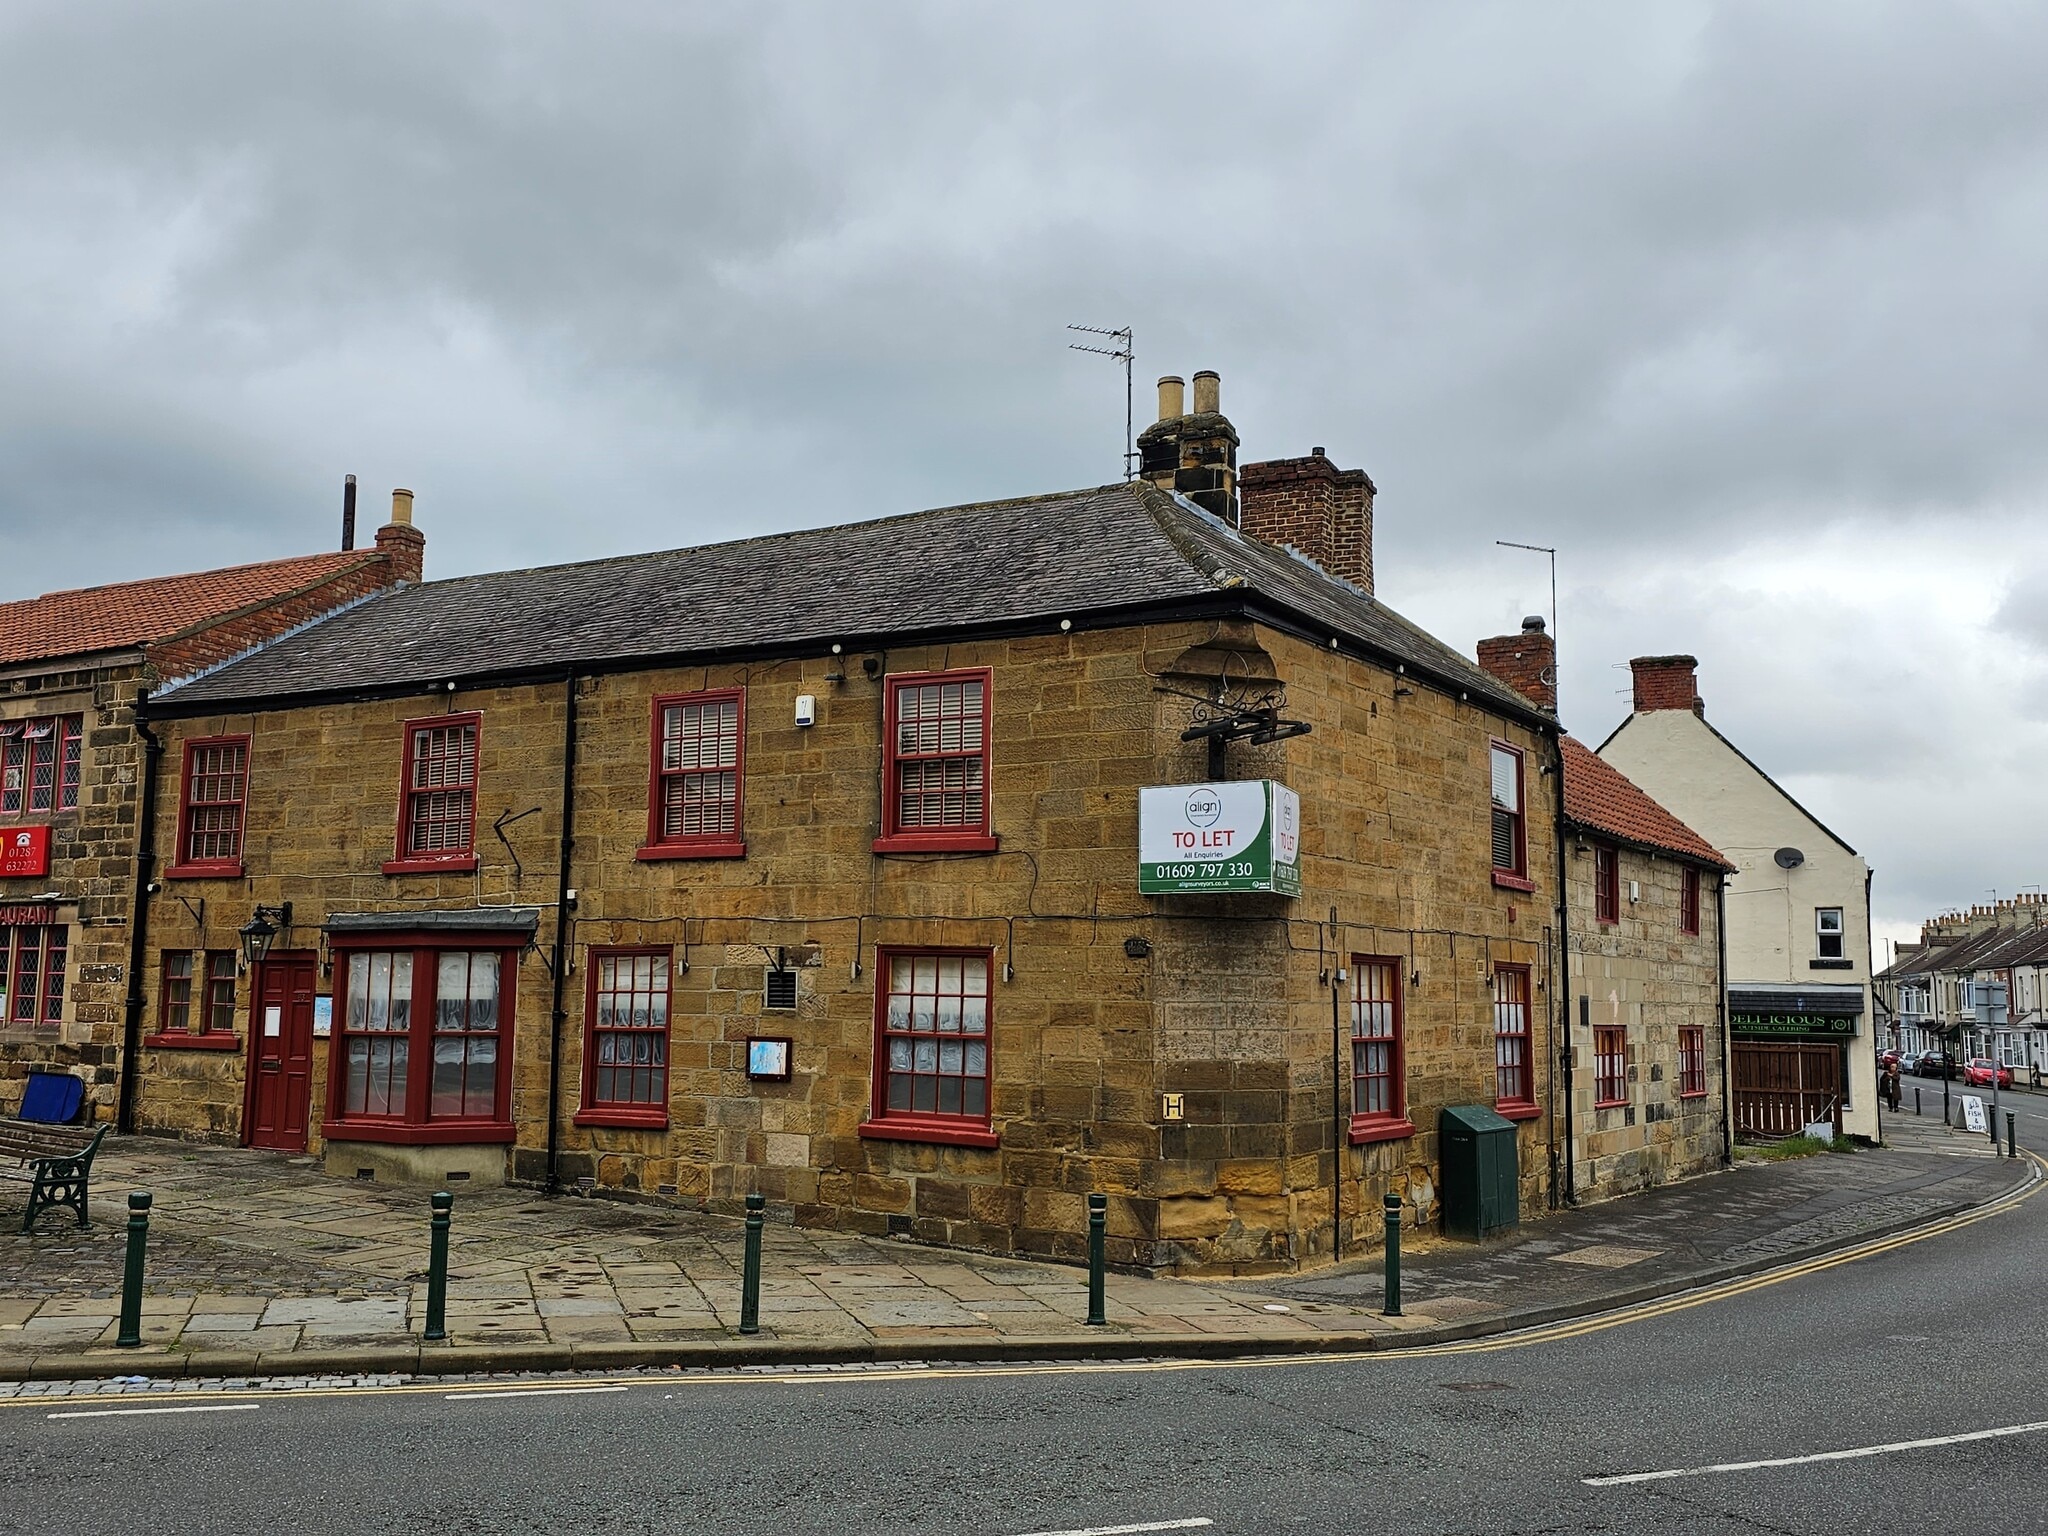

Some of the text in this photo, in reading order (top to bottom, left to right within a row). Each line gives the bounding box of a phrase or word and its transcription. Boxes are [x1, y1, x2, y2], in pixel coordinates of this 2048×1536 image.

[1189, 801, 1217, 814] align
[1172, 829, 1235, 848] TO LET
[8, 847, 37, 858] 01287
[1194, 851, 1224, 859] Enquiries
[6, 860, 37, 872] 632272
[1156, 861, 1253, 879] 01609 797 330
[1166, 1097, 1181, 1116] H
[1968, 1124, 1987, 1132] CHIPS
